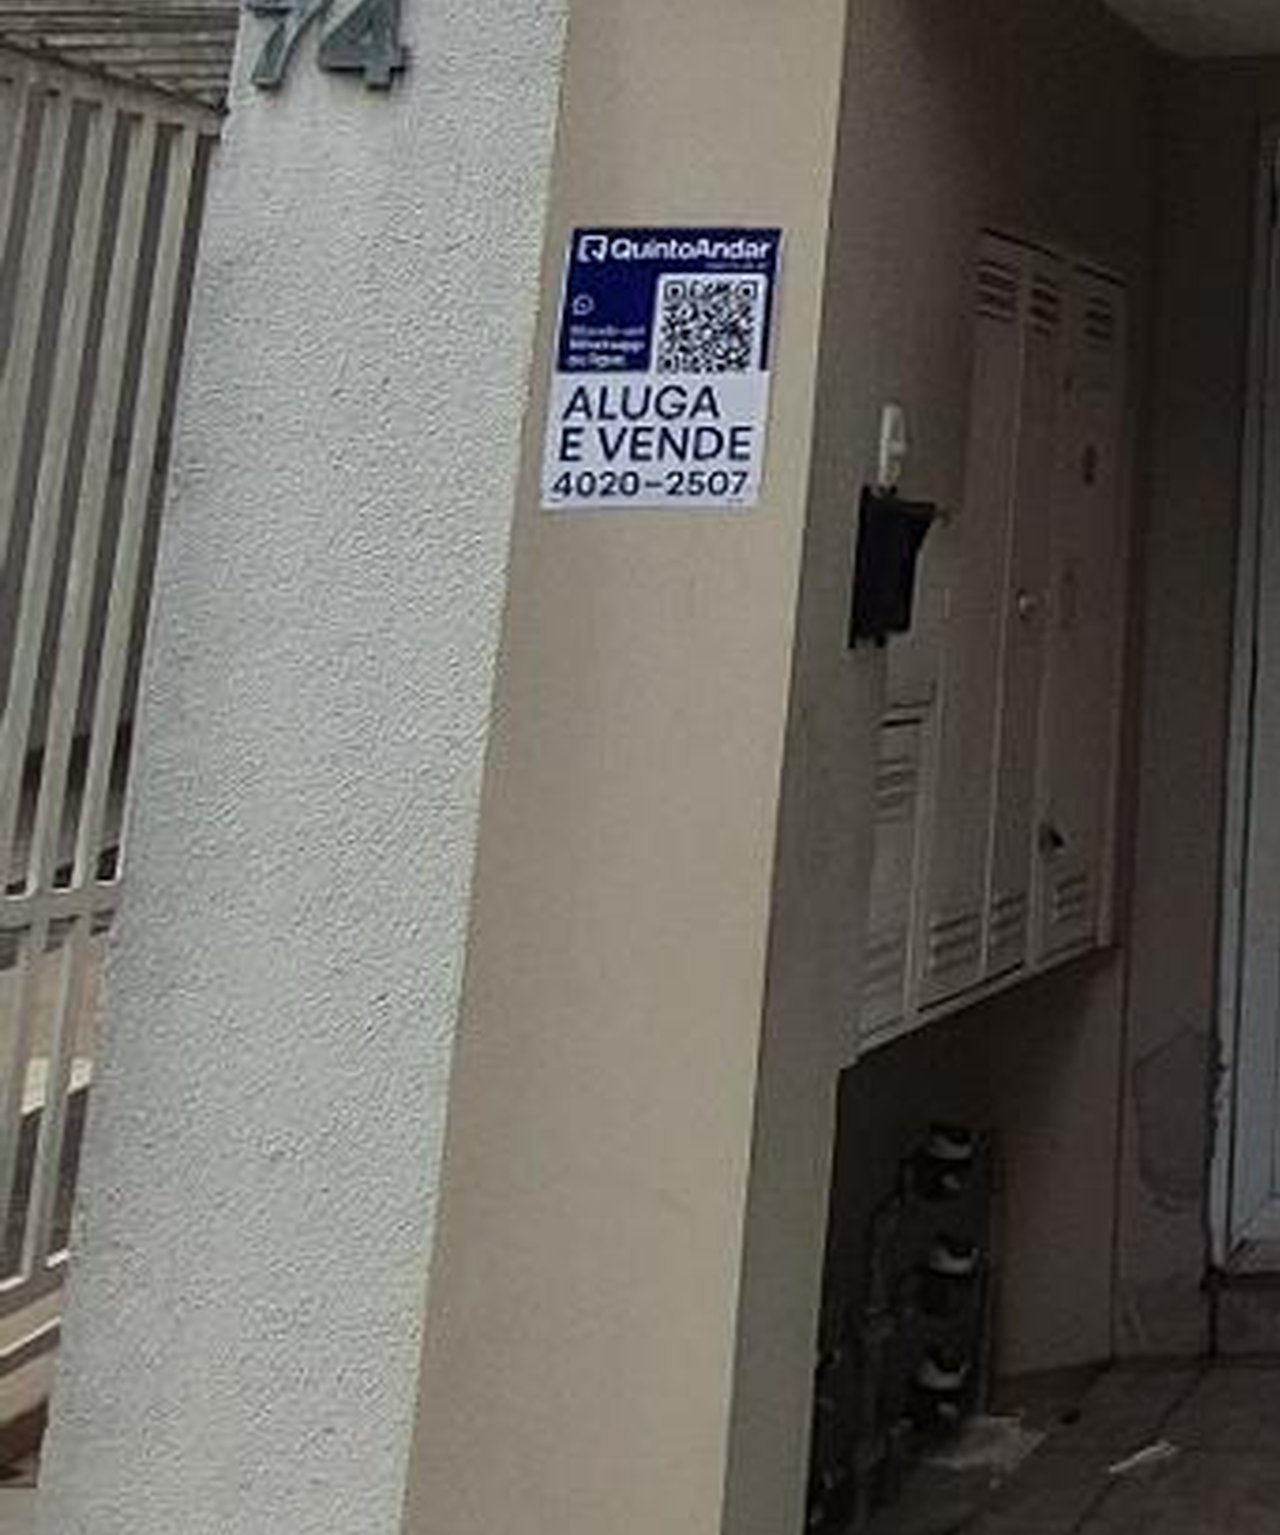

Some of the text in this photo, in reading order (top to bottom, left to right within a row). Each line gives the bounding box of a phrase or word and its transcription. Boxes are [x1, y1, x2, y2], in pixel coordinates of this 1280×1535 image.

[611, 238, 771, 261] QuintoAndar
[562, 385, 720, 421] ALUGA
[559, 426, 753, 462] E VENDE
[553, 471, 749, 497] 4020-2507
